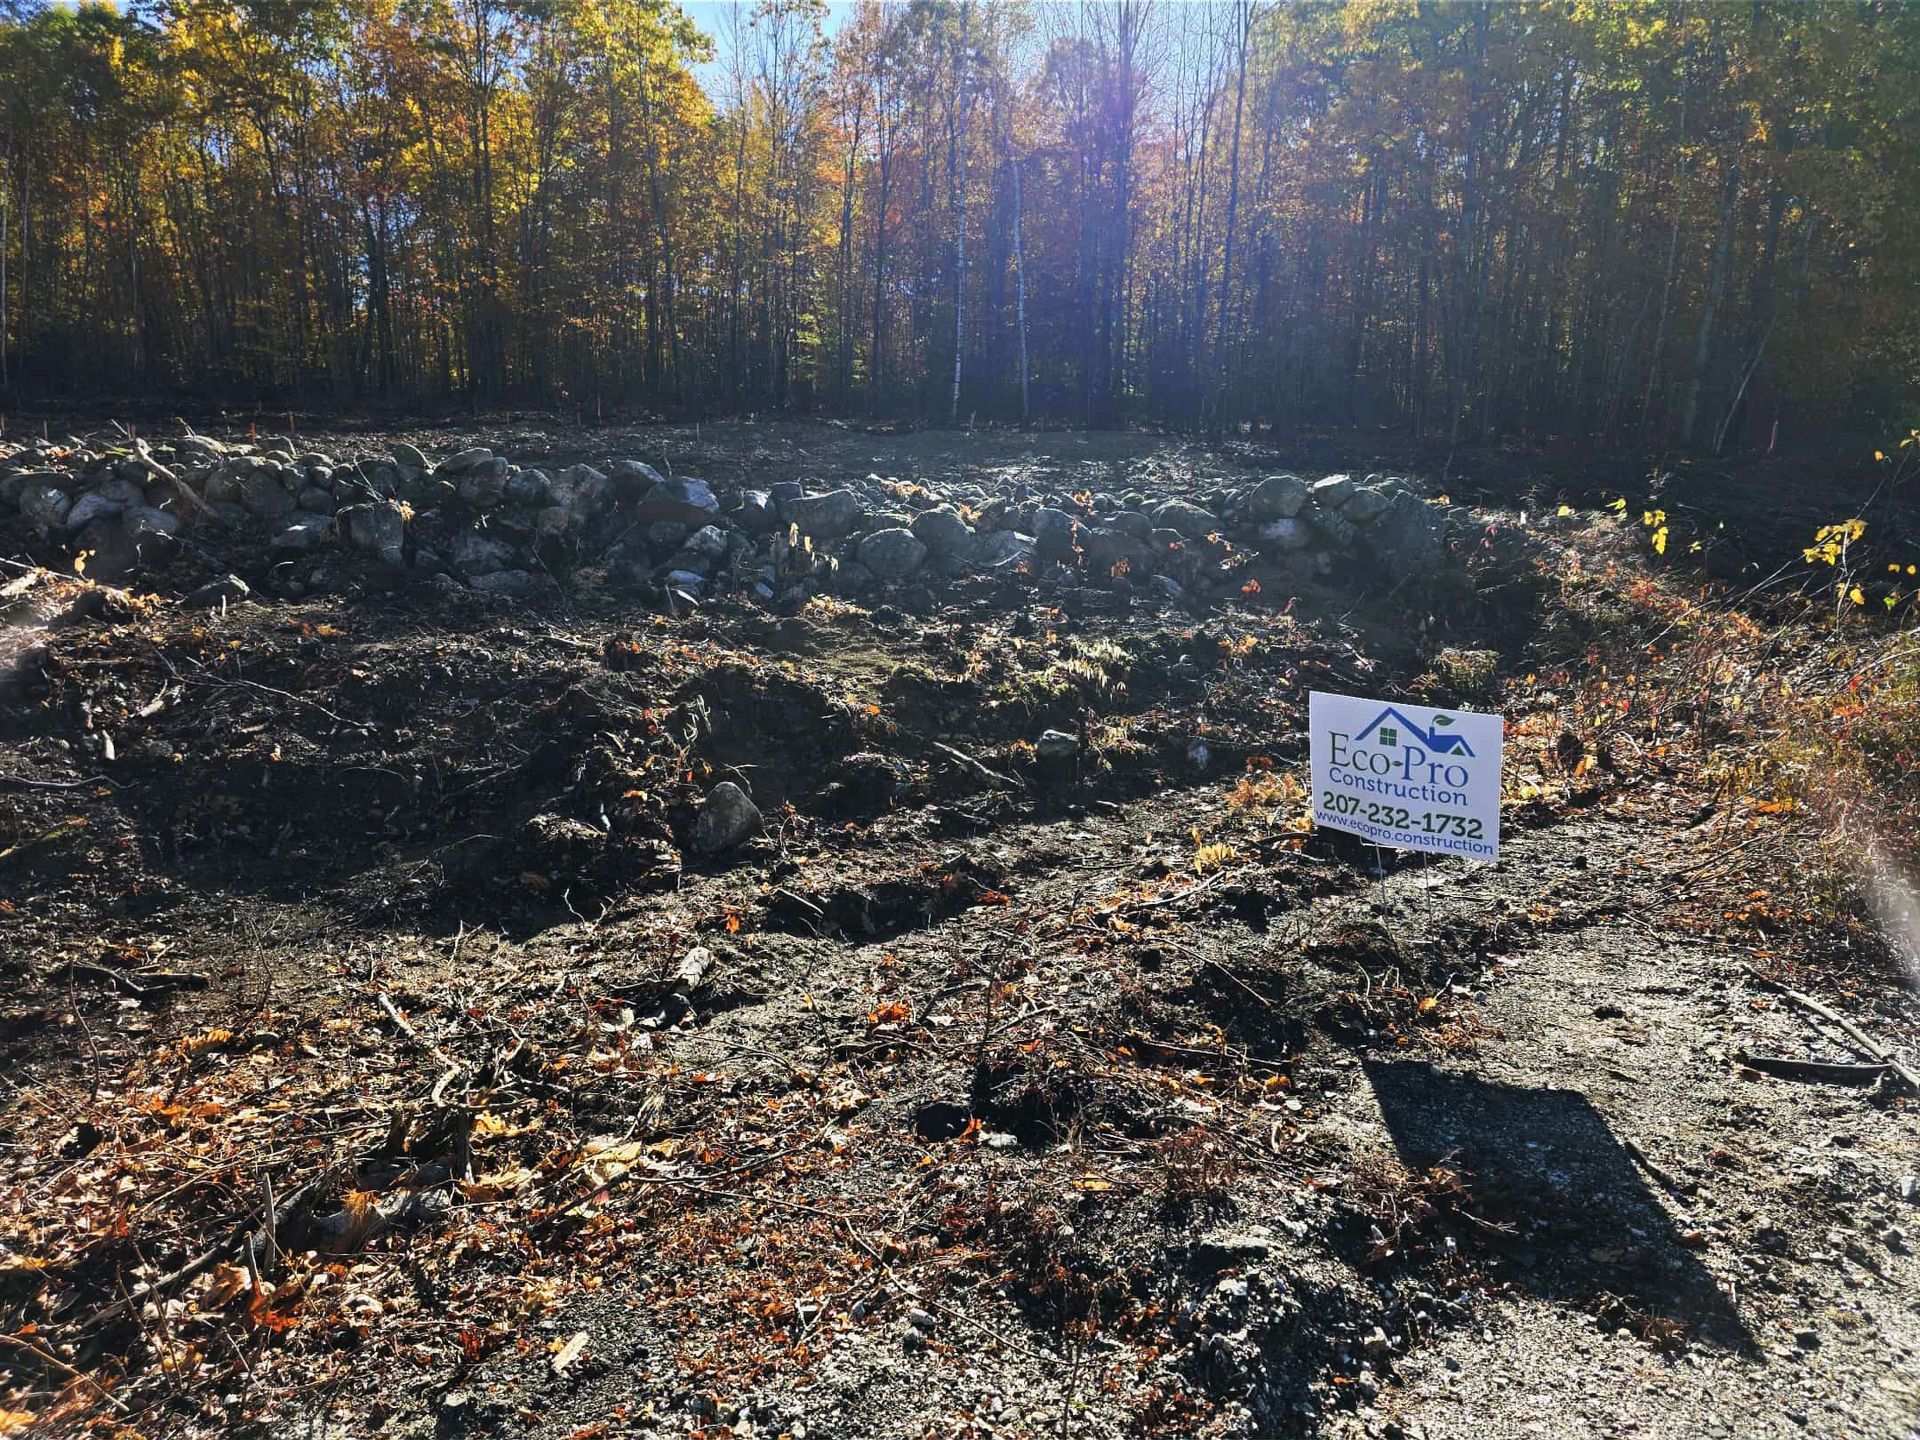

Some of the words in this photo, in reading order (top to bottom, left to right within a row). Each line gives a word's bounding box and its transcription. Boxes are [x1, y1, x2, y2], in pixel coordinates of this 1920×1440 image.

[1328, 731, 1469, 788] Eco-Pro
[1329, 767, 1468, 806] Construction
[1316, 810, 1494, 855] www.ecopro.construction
[1323, 791, 1483, 839] 207-232-1732
